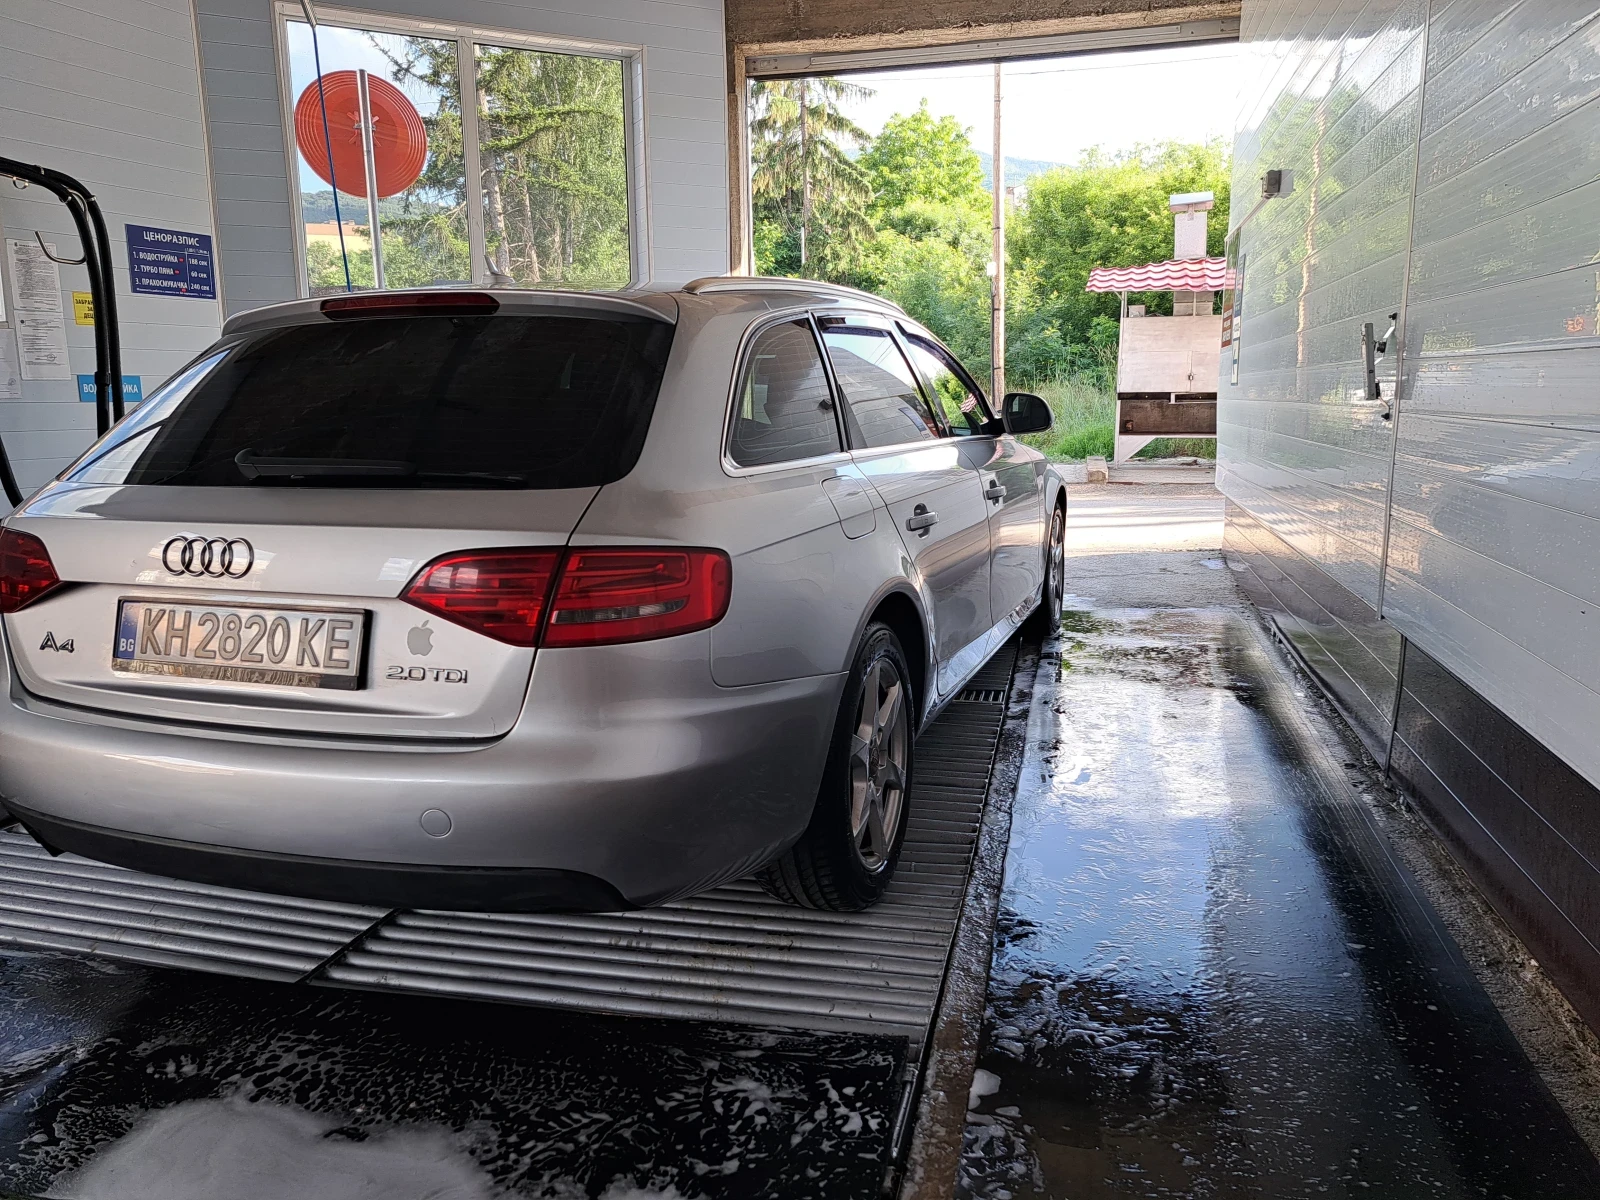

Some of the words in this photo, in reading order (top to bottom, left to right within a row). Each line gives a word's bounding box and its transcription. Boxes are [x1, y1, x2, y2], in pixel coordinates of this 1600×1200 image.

[143, 230, 200, 247] ЦЕНОРАЗПИС
[139, 252, 178, 263] ВОДОСТРУЙКА
[188, 257, 198, 265] 188
[140, 265, 158, 274] ТУРБО
[158, 266, 174, 275] ПЯНА
[141, 278, 188, 289] ПРАХОСМУКАЧКА
[39, 631, 75, 653] A4
[119, 638, 135, 652] BG
[140, 608, 192, 657] KH
[194, 611, 291, 664] 2820
[296, 617, 354, 669] KE
[386, 665, 426, 682] 2.0
[427, 667, 468, 684] TDI
